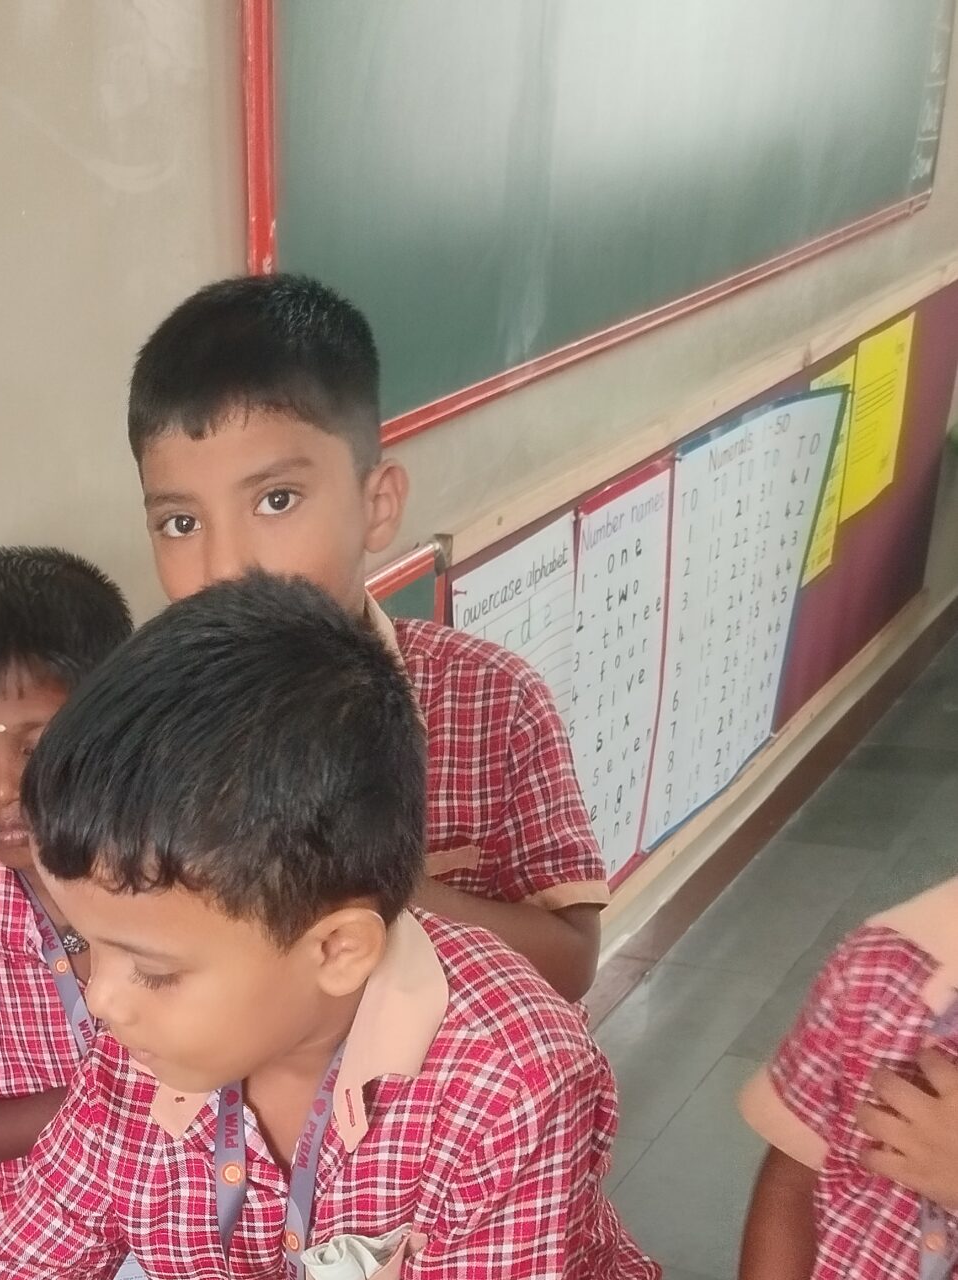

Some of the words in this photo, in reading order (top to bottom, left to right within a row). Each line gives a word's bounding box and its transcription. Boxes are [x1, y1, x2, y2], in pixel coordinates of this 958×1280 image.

[709, 426, 754, 473] Numerals
[581, 509, 626, 552] Number
[630, 491, 666, 523] names
[575, 610, 584, 634] 2
[572, 651, 580, 673] 3
[571, 685, 578, 706] 4
[224, 1111, 239, 1149] PVM
[297, 1120, 318, 1169] PVBM
